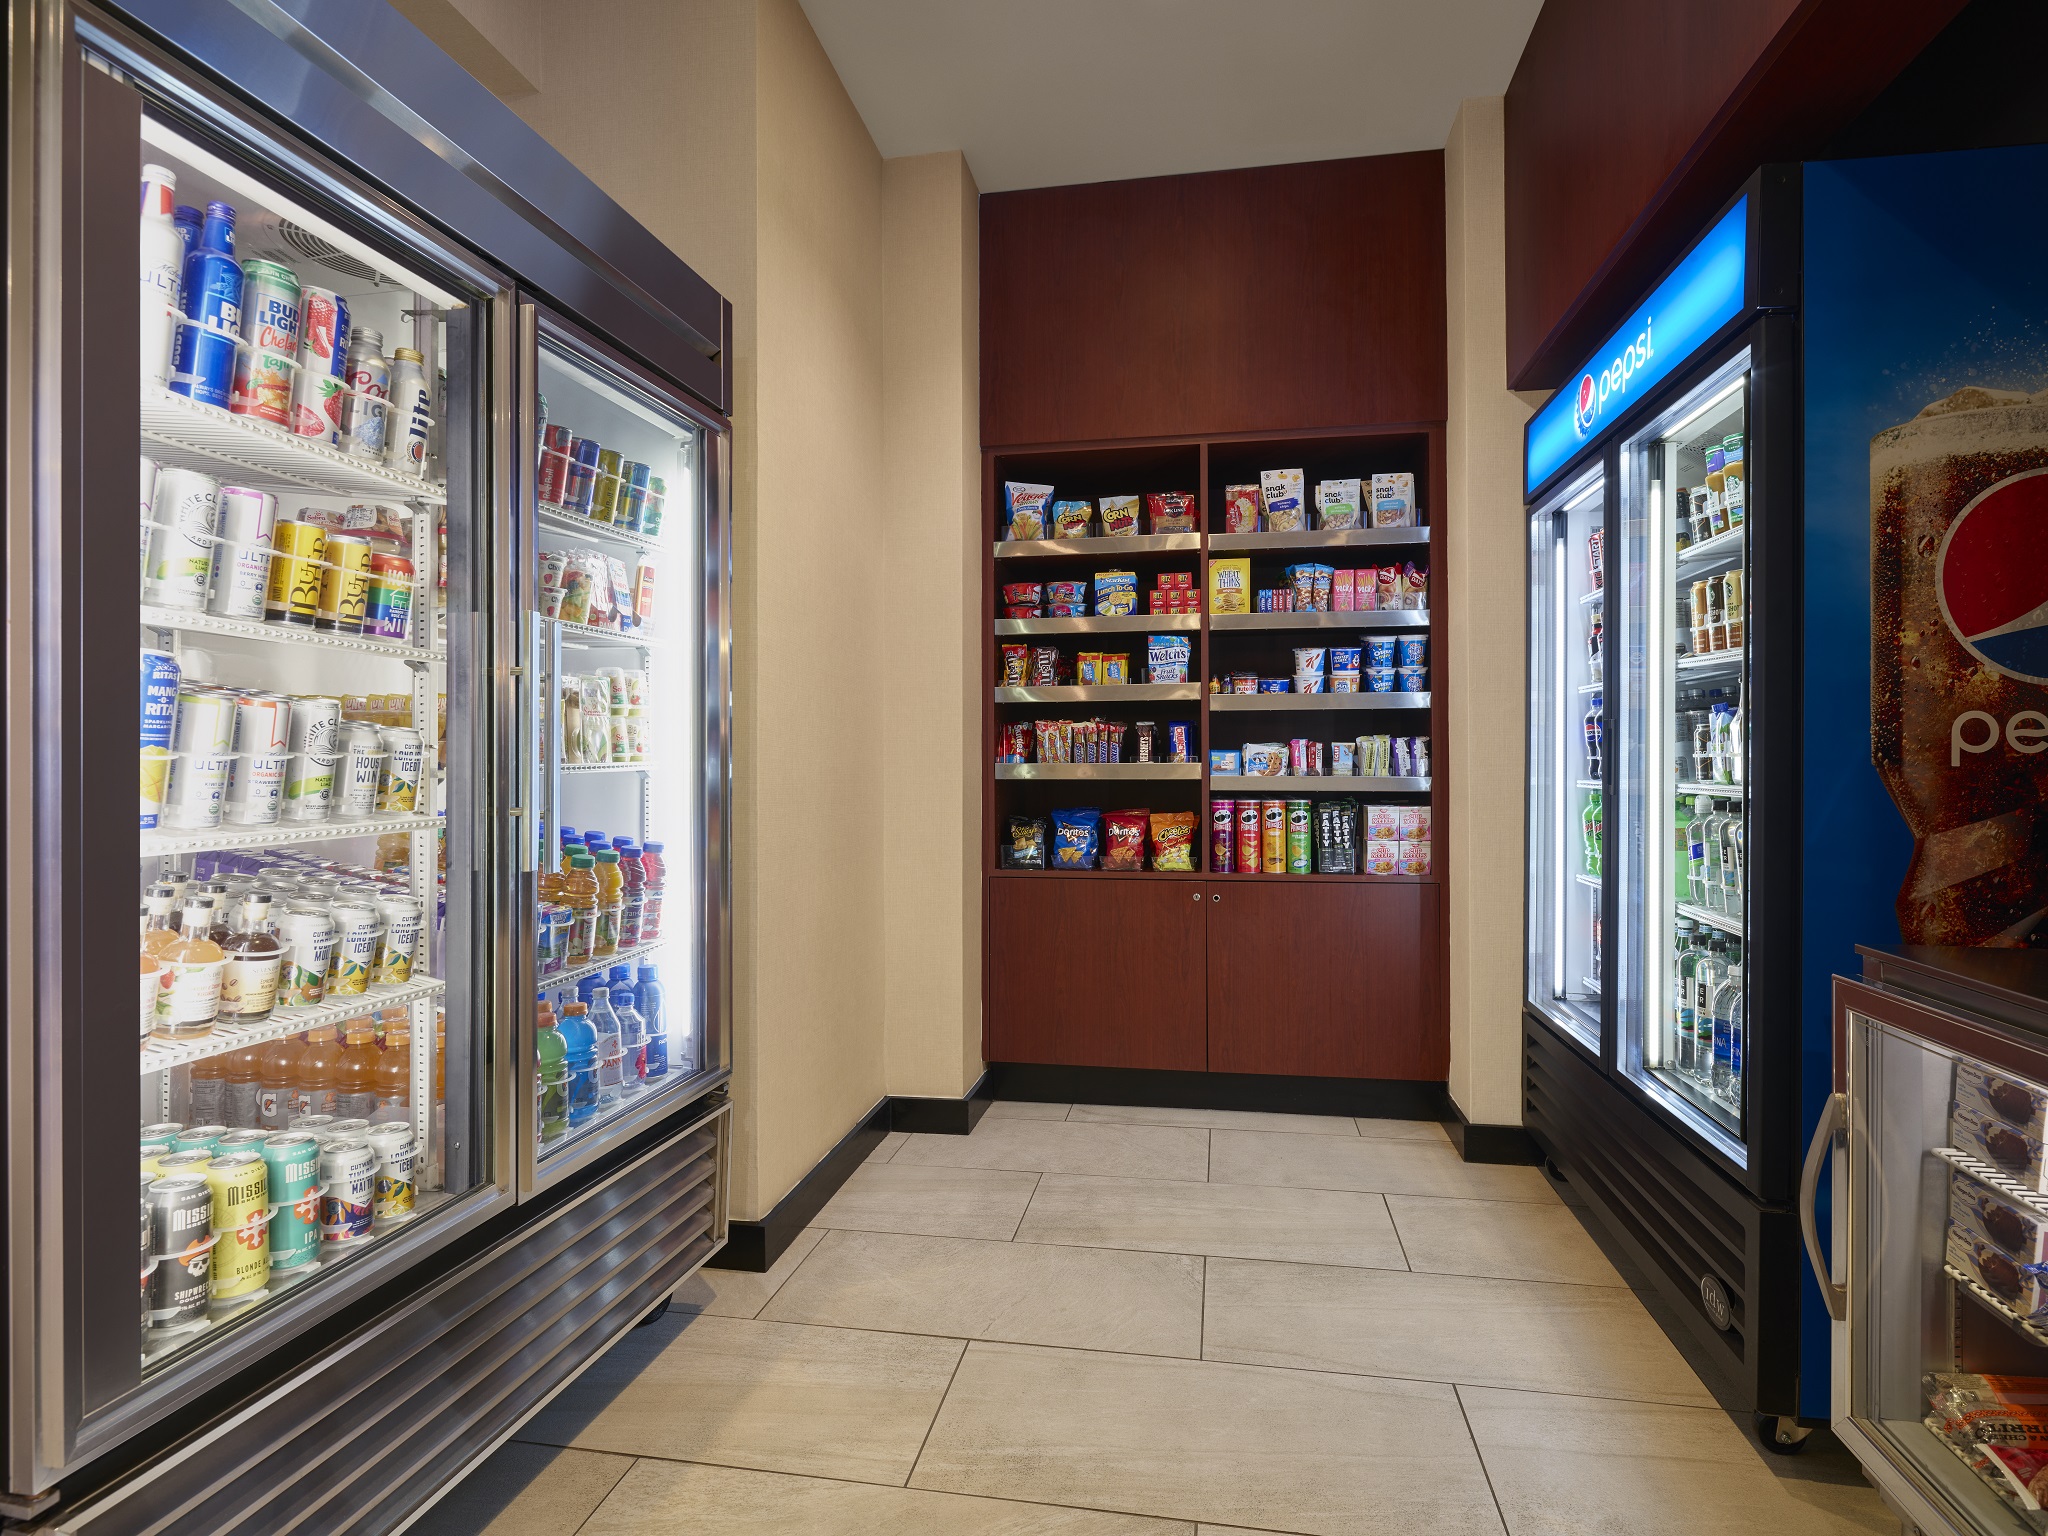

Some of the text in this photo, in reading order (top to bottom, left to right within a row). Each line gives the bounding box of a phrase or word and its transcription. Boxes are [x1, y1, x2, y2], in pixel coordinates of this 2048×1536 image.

[1598, 316, 1652, 415] pepsi
[1265, 484, 1286, 492] snak
[1266, 491, 1285, 499] club
[1058, 513, 1082, 524] CORN
[1103, 507, 1129, 523] CORN
[1109, 517, 1133, 532] NUTS
[1217, 570, 1240, 579] WHEAT
[1218, 578, 1241, 588] THINS
[1097, 587, 1115, 596] Lunch
[1335, 585, 1354, 593] Pocky
[1357, 585, 1376, 594] Pocky
[1150, 648, 1186, 662] Welch's
[1014, 724, 1024, 752] Skittles
[1176, 727, 1185, 754] CRUNCH
[1950, 710, 2048, 767] pe
[1213, 823, 1232, 832] PRINGLES
[1241, 823, 1258, 832] PRINGLES
[1265, 820, 1283, 830] PRINGLES
[1290, 824, 1308, 832] PRINGLES
[1321, 812, 1330, 847] FATTY
[1332, 810, 1342, 844] FATTY
[1057, 828, 1089, 837] Doritos
[1108, 828, 1140, 837] Doritos
[1157, 825, 1191, 842] Cheetos
[1342, 815, 1350, 849] FATTY
[304, 1232, 318, 1245] IPA
[236, 1261, 262, 1275] BLONDE
